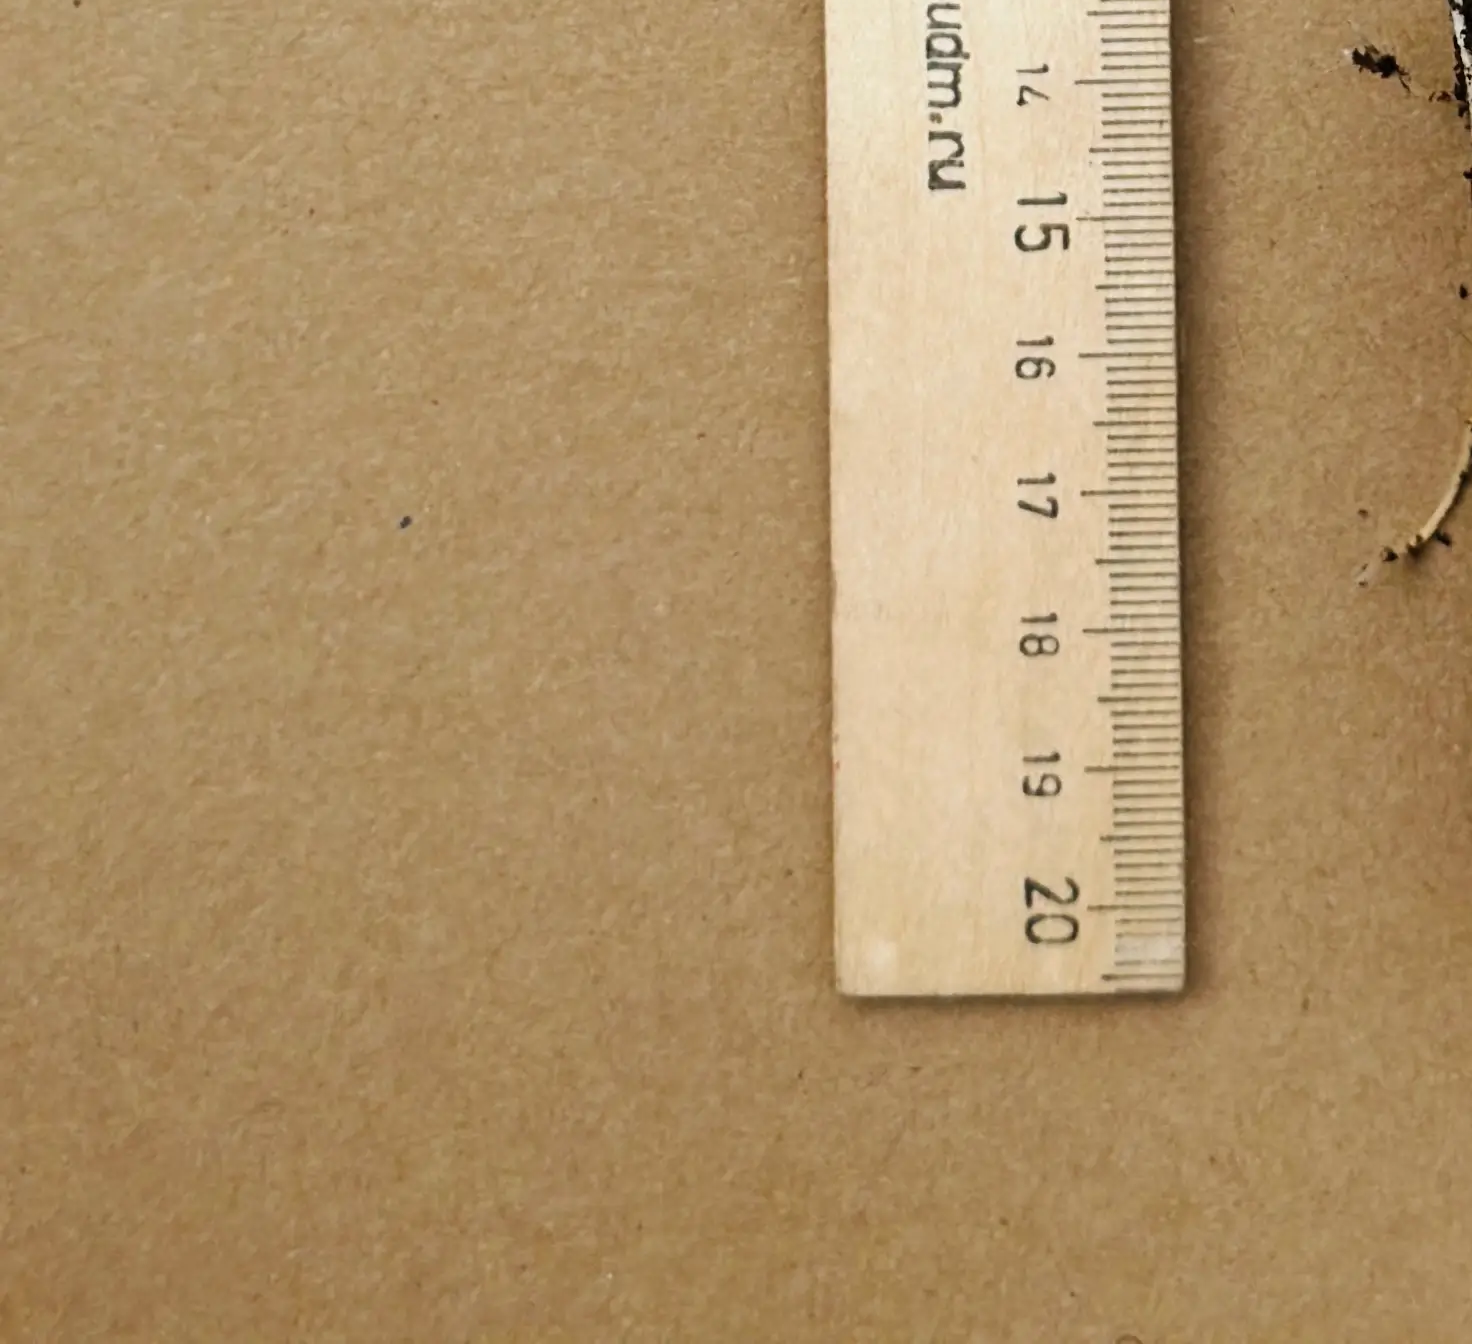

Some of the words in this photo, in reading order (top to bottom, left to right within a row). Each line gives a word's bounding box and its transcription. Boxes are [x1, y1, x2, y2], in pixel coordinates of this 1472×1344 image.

[1015, 63, 1050, 108] 14
[1013, 191, 1071, 253] 15
[1014, 335, 1057, 381] 16
[1016, 472, 1060, 520] 17
[1018, 612, 1061, 658] 18
[1021, 751, 1063, 799] 19
[1023, 876, 1081, 946] 20
